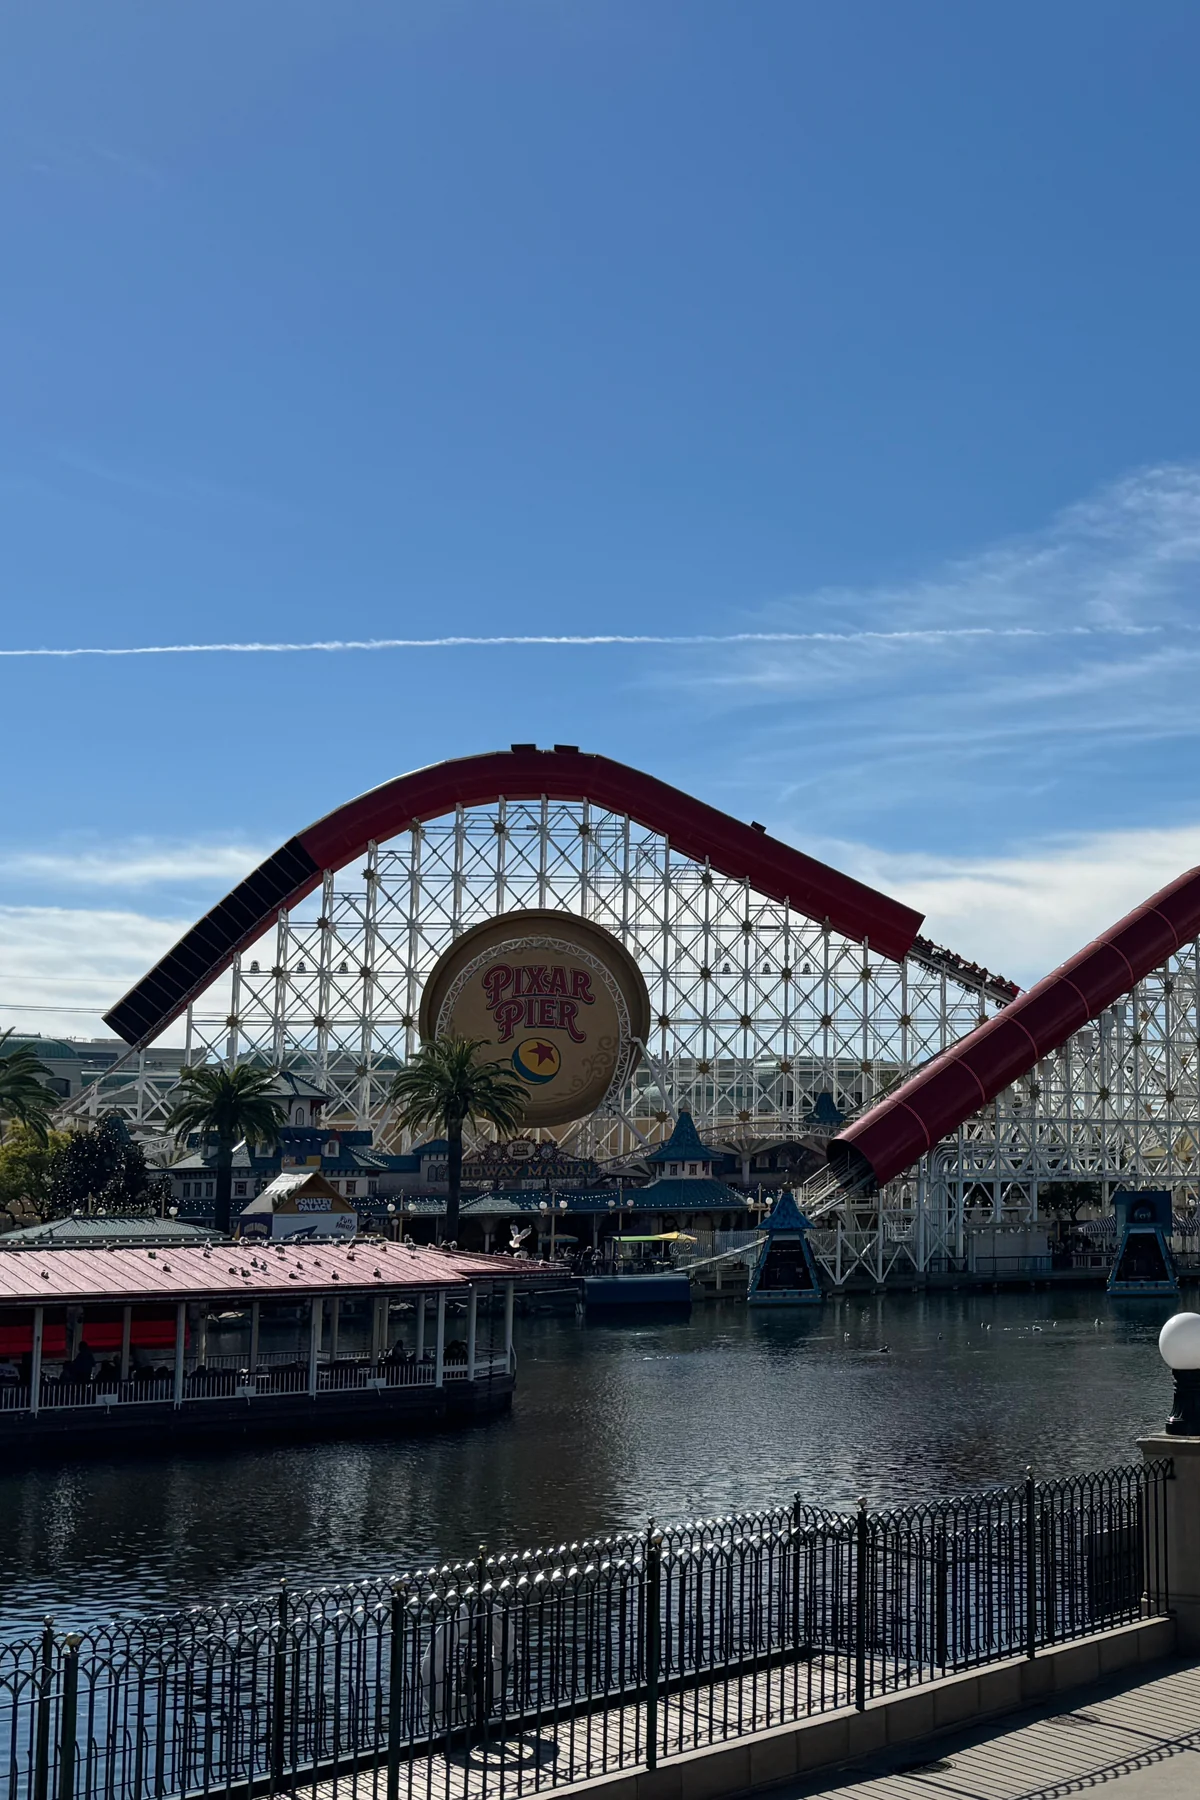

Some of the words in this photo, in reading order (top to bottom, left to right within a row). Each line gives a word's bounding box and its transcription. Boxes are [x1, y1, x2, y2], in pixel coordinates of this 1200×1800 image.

[482, 963, 596, 1010] PIXAR
[493, 997, 586, 1043] PIER
[512, 1143, 530, 1152] TOY
[460, 1165, 522, 1177] IDWAY
[527, 1164, 592, 1177] MANIA!
[295, 1197, 334, 1205] POULTRY
